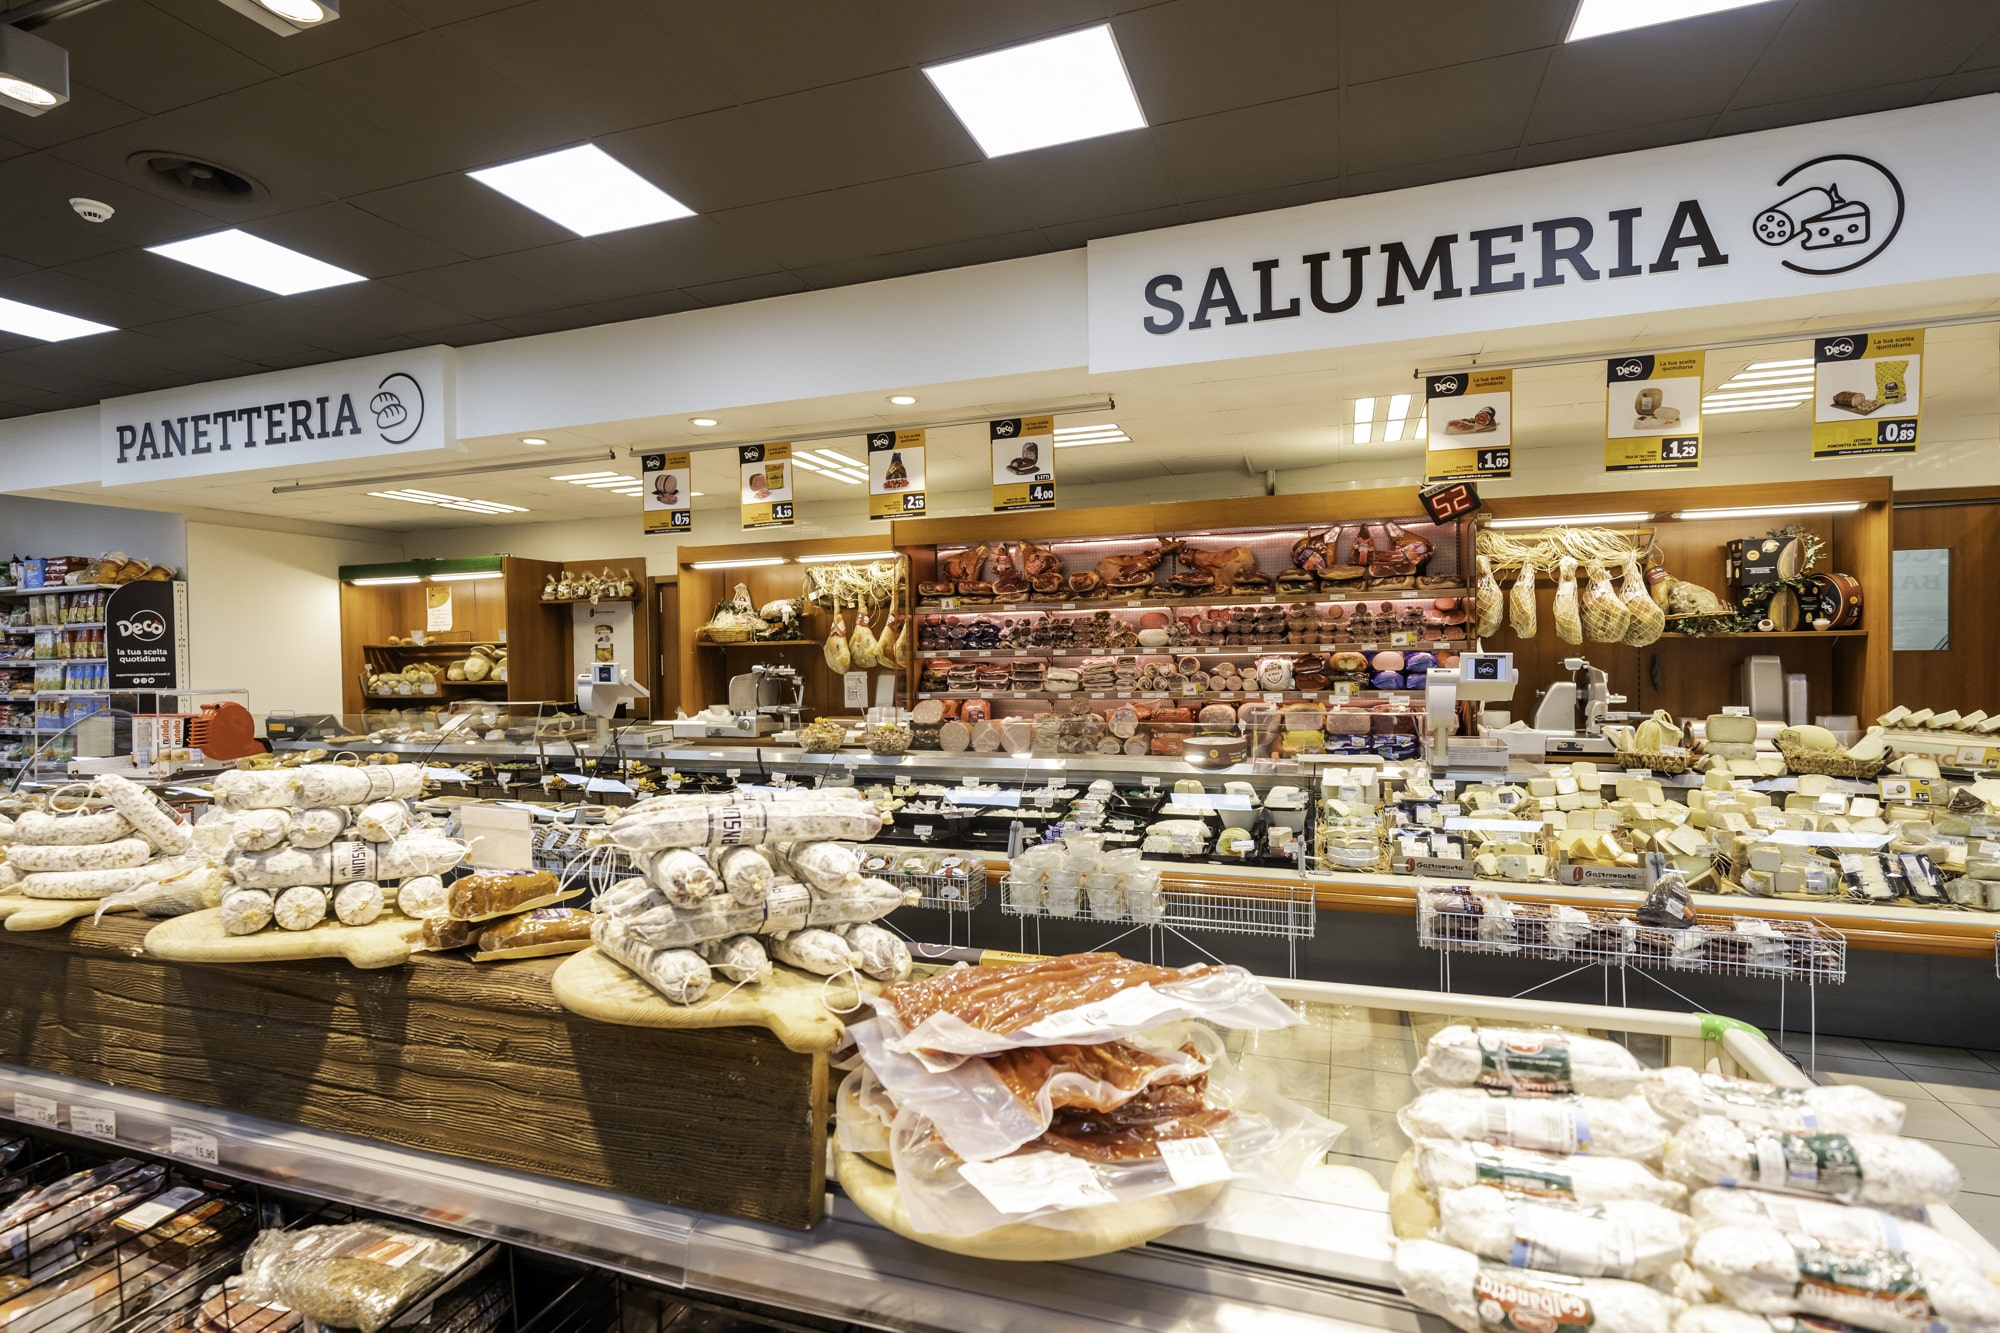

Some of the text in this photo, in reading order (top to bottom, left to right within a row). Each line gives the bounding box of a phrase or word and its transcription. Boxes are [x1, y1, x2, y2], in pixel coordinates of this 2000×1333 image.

[1142, 199, 1729, 336] SALUMERIA
[1876, 342, 1912, 350] quotidiana
[116, 393, 362, 464] PANETTERIA
[1885, 423, 1915, 442] 0,89
[1669, 440, 1697, 458] 1,29
[1484, 452, 1509, 469] 1,09
[1034, 486, 1054, 499] 4,00
[907, 495, 924, 509] 2,19
[1432, 485, 1470, 518] 52
[776, 504, 792, 518] 1,19
[675, 512, 690, 526] 0,79
[127, 648, 142, 656] tua
[143, 648, 168, 656] scelta
[119, 655, 166, 664] quotidiana
[161, 719, 170, 745] nutella
[173, 720, 182, 745] nutella
[1416, 861, 1464, 872] Gastronauta
[1585, 870, 1637, 880] Gastronauta
[94, 1123, 114, 1136] 13,90
[194, 1145, 216, 1160] 15,90
[1476, 1275, 1587, 1319] Galbanetto
